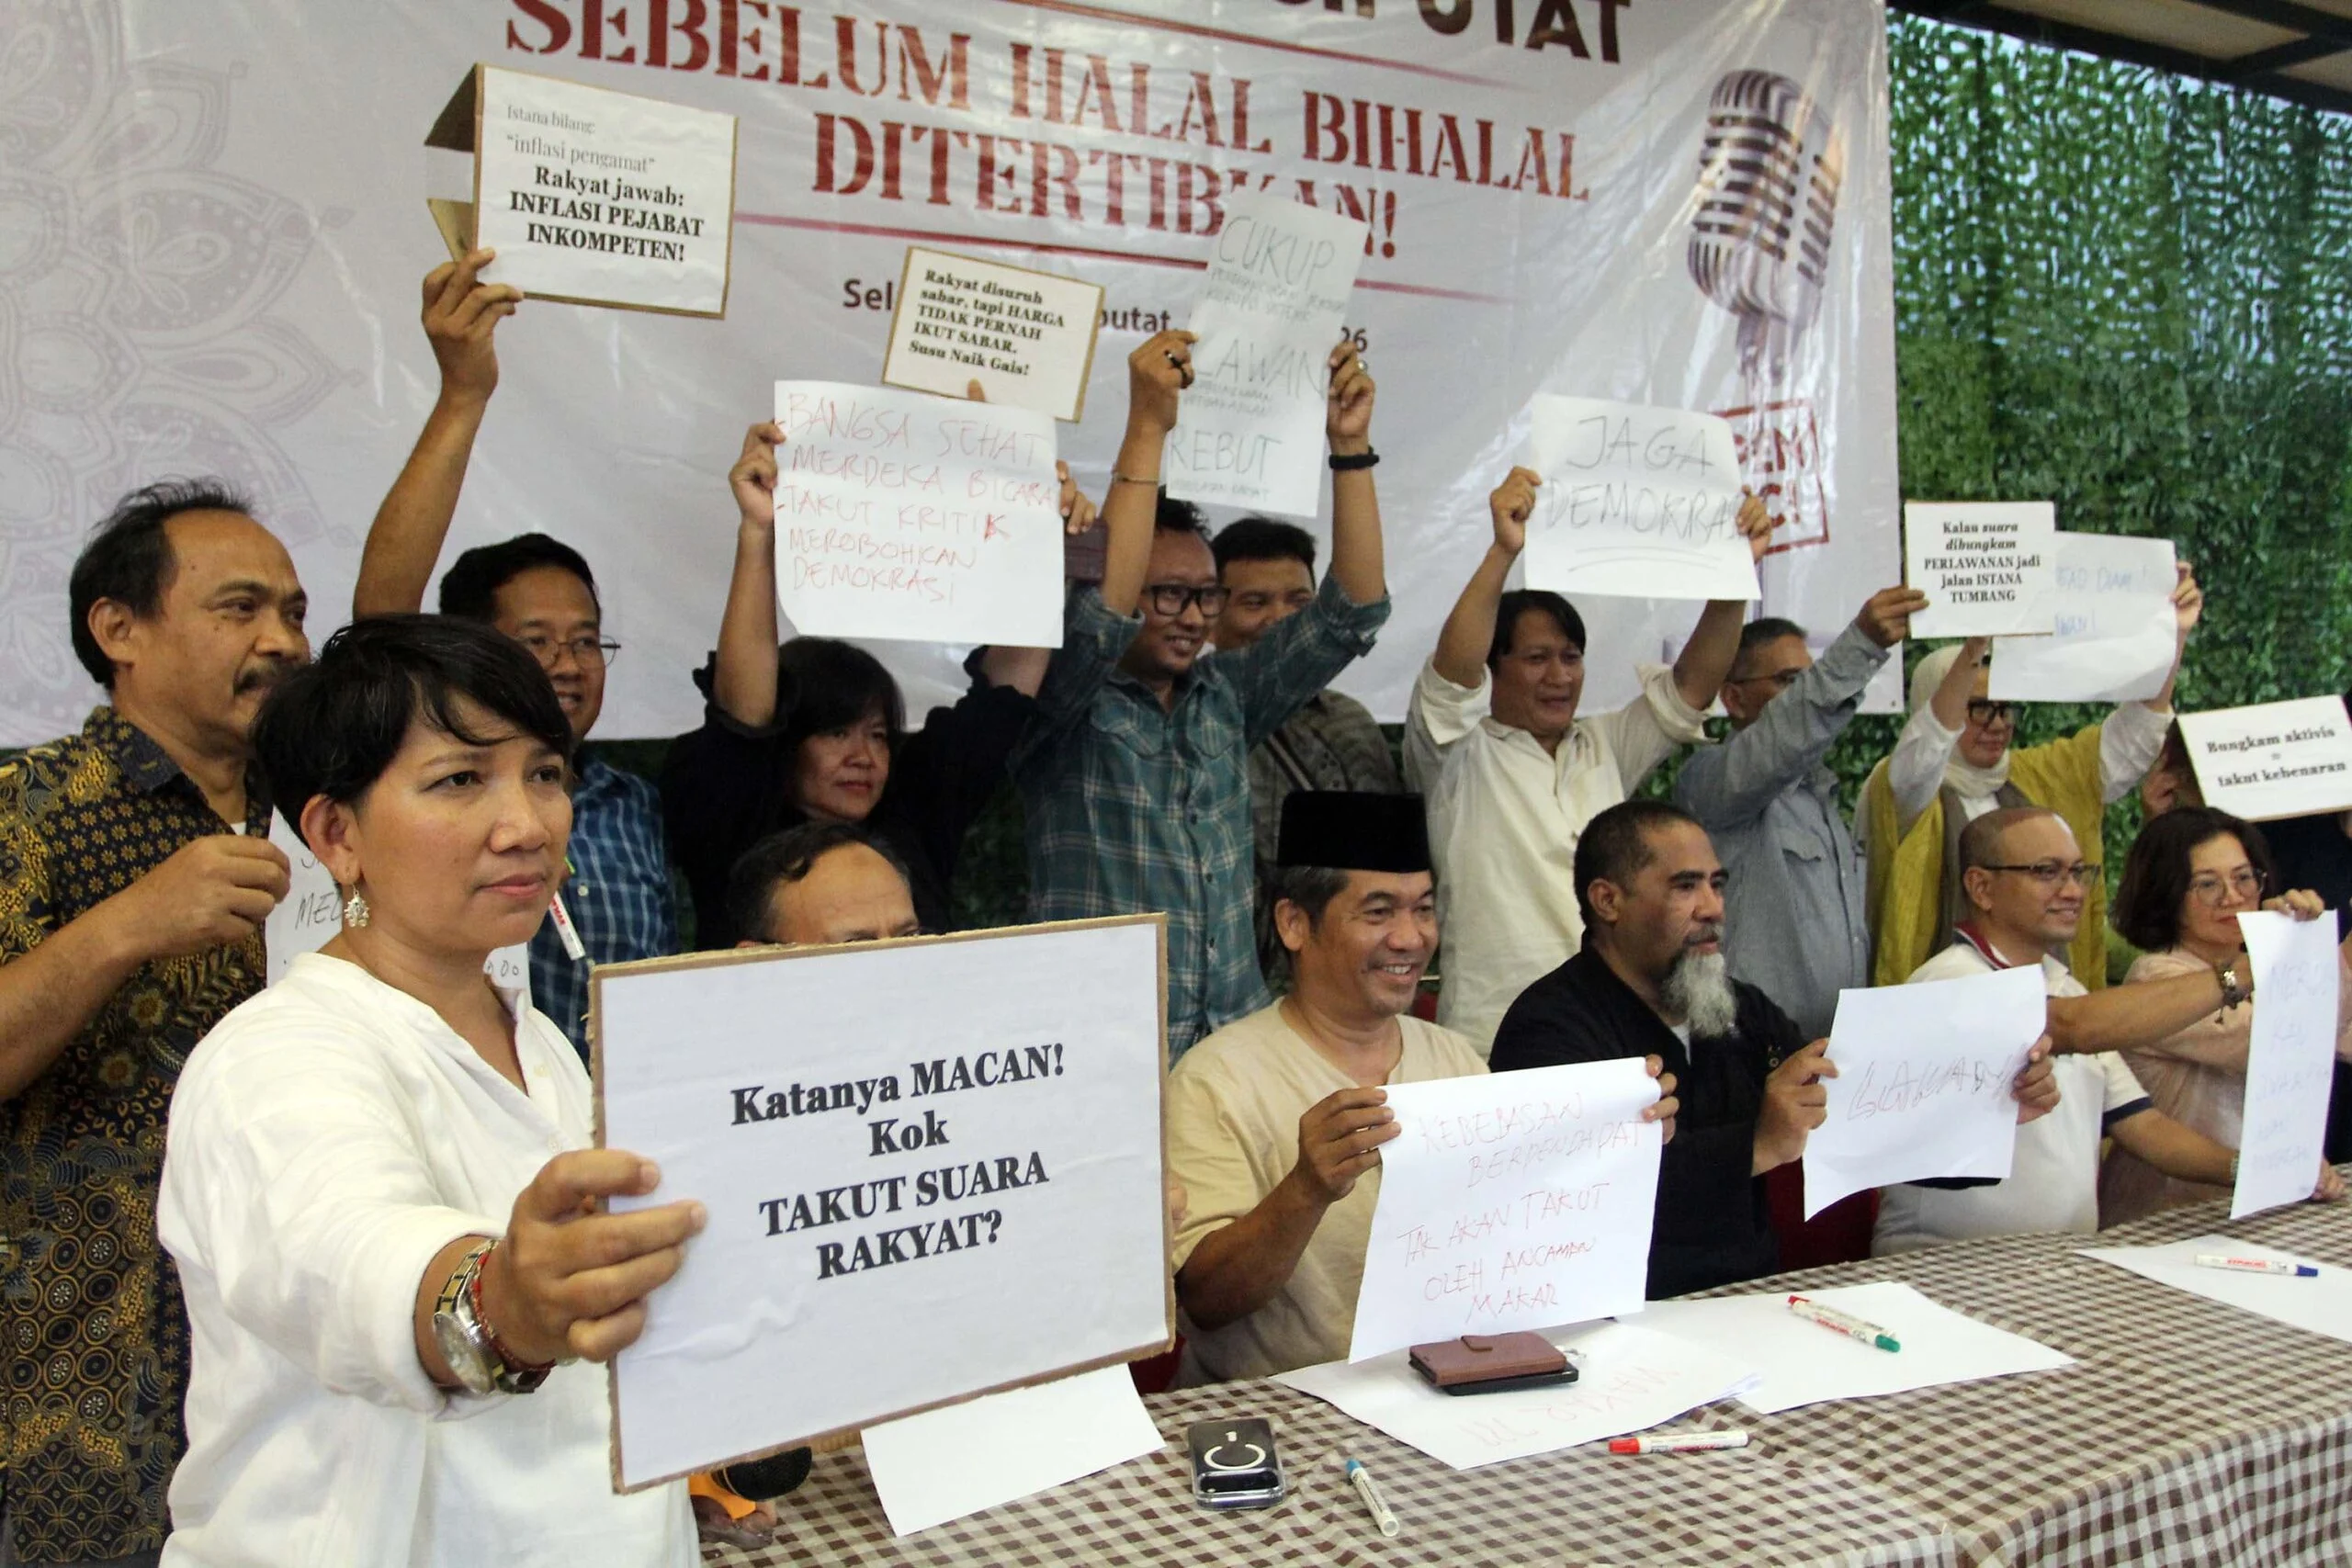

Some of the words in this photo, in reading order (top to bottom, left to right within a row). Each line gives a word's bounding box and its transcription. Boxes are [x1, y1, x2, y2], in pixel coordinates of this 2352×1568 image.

[507, 0, 970, 110] SEBELUM
[1009, 42, 1272, 154] HALAL
[1302, 89, 1589, 201] BIHALAL
[507, 105, 548, 126] Istana
[535, 164, 610, 196] Rakyat
[612, 177, 684, 207] jawab:
[812, 111, 1396, 259] DITERTIBN!
[510, 190, 600, 223] INFLASI
[608, 205, 705, 237] PEJABAT
[527, 222, 684, 262] INKOMPETEN!
[1218, 215, 1335, 292] CUKUP
[842, 278, 893, 311] Sel
[925, 269, 978, 292] Rakyat
[982, 281, 1043, 304] disuruh
[918, 303, 968, 326] TIDAK
[974, 314, 1042, 340] PERNAH
[974, 298, 1003, 315] tapi
[1008, 305, 1065, 328] HARGA
[909, 340, 946, 359] Susu
[950, 348, 986, 367] Naik
[989, 356, 1030, 377] Gais!
[914, 321, 956, 341] IKUT
[957, 331, 1017, 354] SABAR.
[789, 393, 911, 449] BANGSA
[936, 419, 1048, 466] SEHAT
[1566, 415, 1714, 477] JAGA
[1170, 423, 1283, 481] REBUT
[792, 445, 944, 494] MERDEKA
[967, 469, 1057, 507] BICARA
[783, 484, 874, 523] TAKUT
[898, 503, 1010, 542] KRITIK
[1943, 521, 1978, 534] Kalau
[1982, 522, 2018, 533] suara
[789, 528, 978, 570] MEROBOHKAN
[1924, 557, 2014, 570] PERLAWANAN
[2015, 555, 2041, 570] jadi
[1946, 537, 2016, 551] dibungkam
[1941, 574, 1973, 589] jalan
[1976, 573, 2022, 585] ISTANA
[1951, 591, 2016, 604] TUMBANG
[2207, 735, 2280, 753] Bungkam
[2285, 726, 2335, 742] aktivis
[2217, 772, 2260, 787] takut
[2262, 761, 2346, 781] kebenaran
[731, 1074, 900, 1125] Katanya
[910, 1043, 1064, 1097] MACAN!
[868, 1110, 950, 1157] Kok
[759, 1177, 907, 1236] TAKUT
[915, 1151, 1049, 1208] SUARA
[1448, 1204, 1510, 1247] AKAN
[1521, 1182, 1610, 1230] TAKUT
[816, 1209, 1003, 1280] RAKYAT?
[1424, 1258, 1483, 1301] OLEH
[1465, 1283, 1559, 1324] MAKAR
